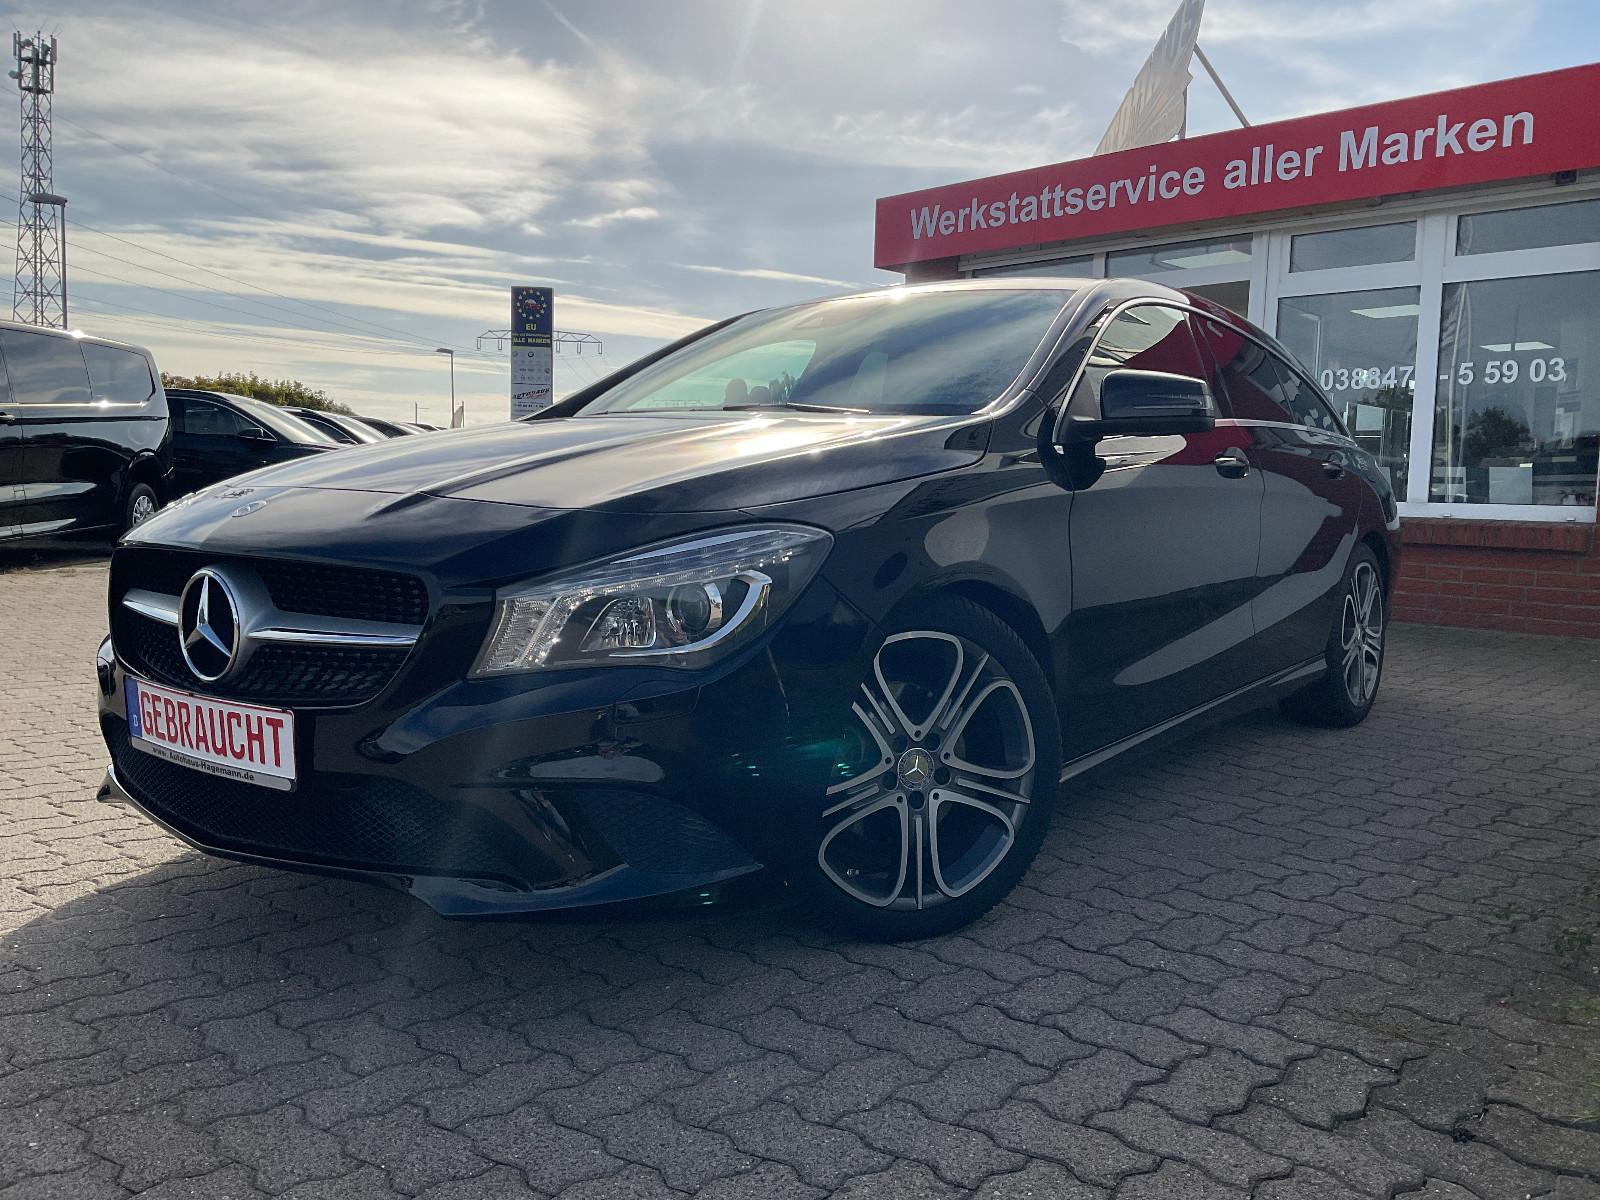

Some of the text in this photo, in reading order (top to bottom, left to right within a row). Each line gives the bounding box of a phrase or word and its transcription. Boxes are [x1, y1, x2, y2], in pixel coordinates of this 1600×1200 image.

[910, 111, 1534, 240] Werkstattservice aller Marken
[525, 323, 537, 331] EU
[1320, 365, 1415, 391] 038847
[1458, 362, 1474, 385] 5
[1484, 360, 1519, 384] 59
[1529, 357, 1565, 382] 03
[140, 690, 284, 768] GEBRAUCHT
